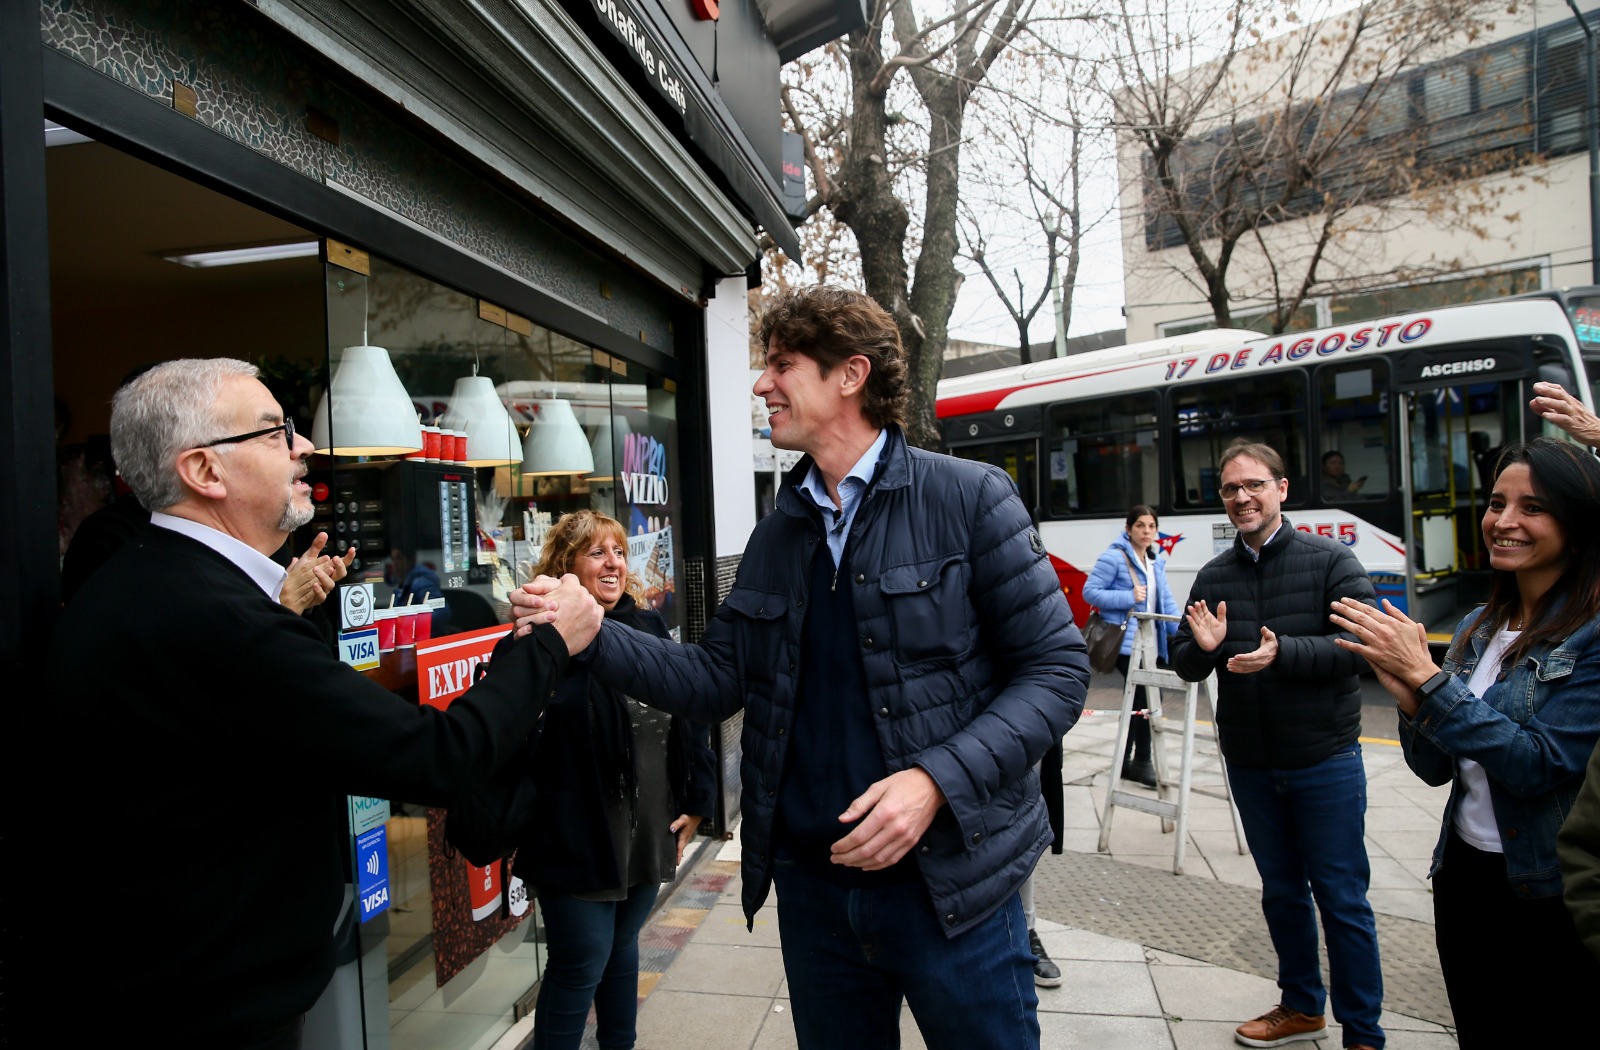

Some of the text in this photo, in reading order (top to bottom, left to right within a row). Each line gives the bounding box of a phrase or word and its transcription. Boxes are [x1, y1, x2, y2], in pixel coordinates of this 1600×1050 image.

[658, 60, 687, 115] Café
[1165, 317, 1433, 381] 17 DE AGOSTO
[1421, 357, 1496, 378] ASCENSO
[1162, 538, 1173, 548] 26
[353, 614, 363, 622] pago
[347, 641, 375, 661] VISA
[362, 887, 389, 913] VISA
